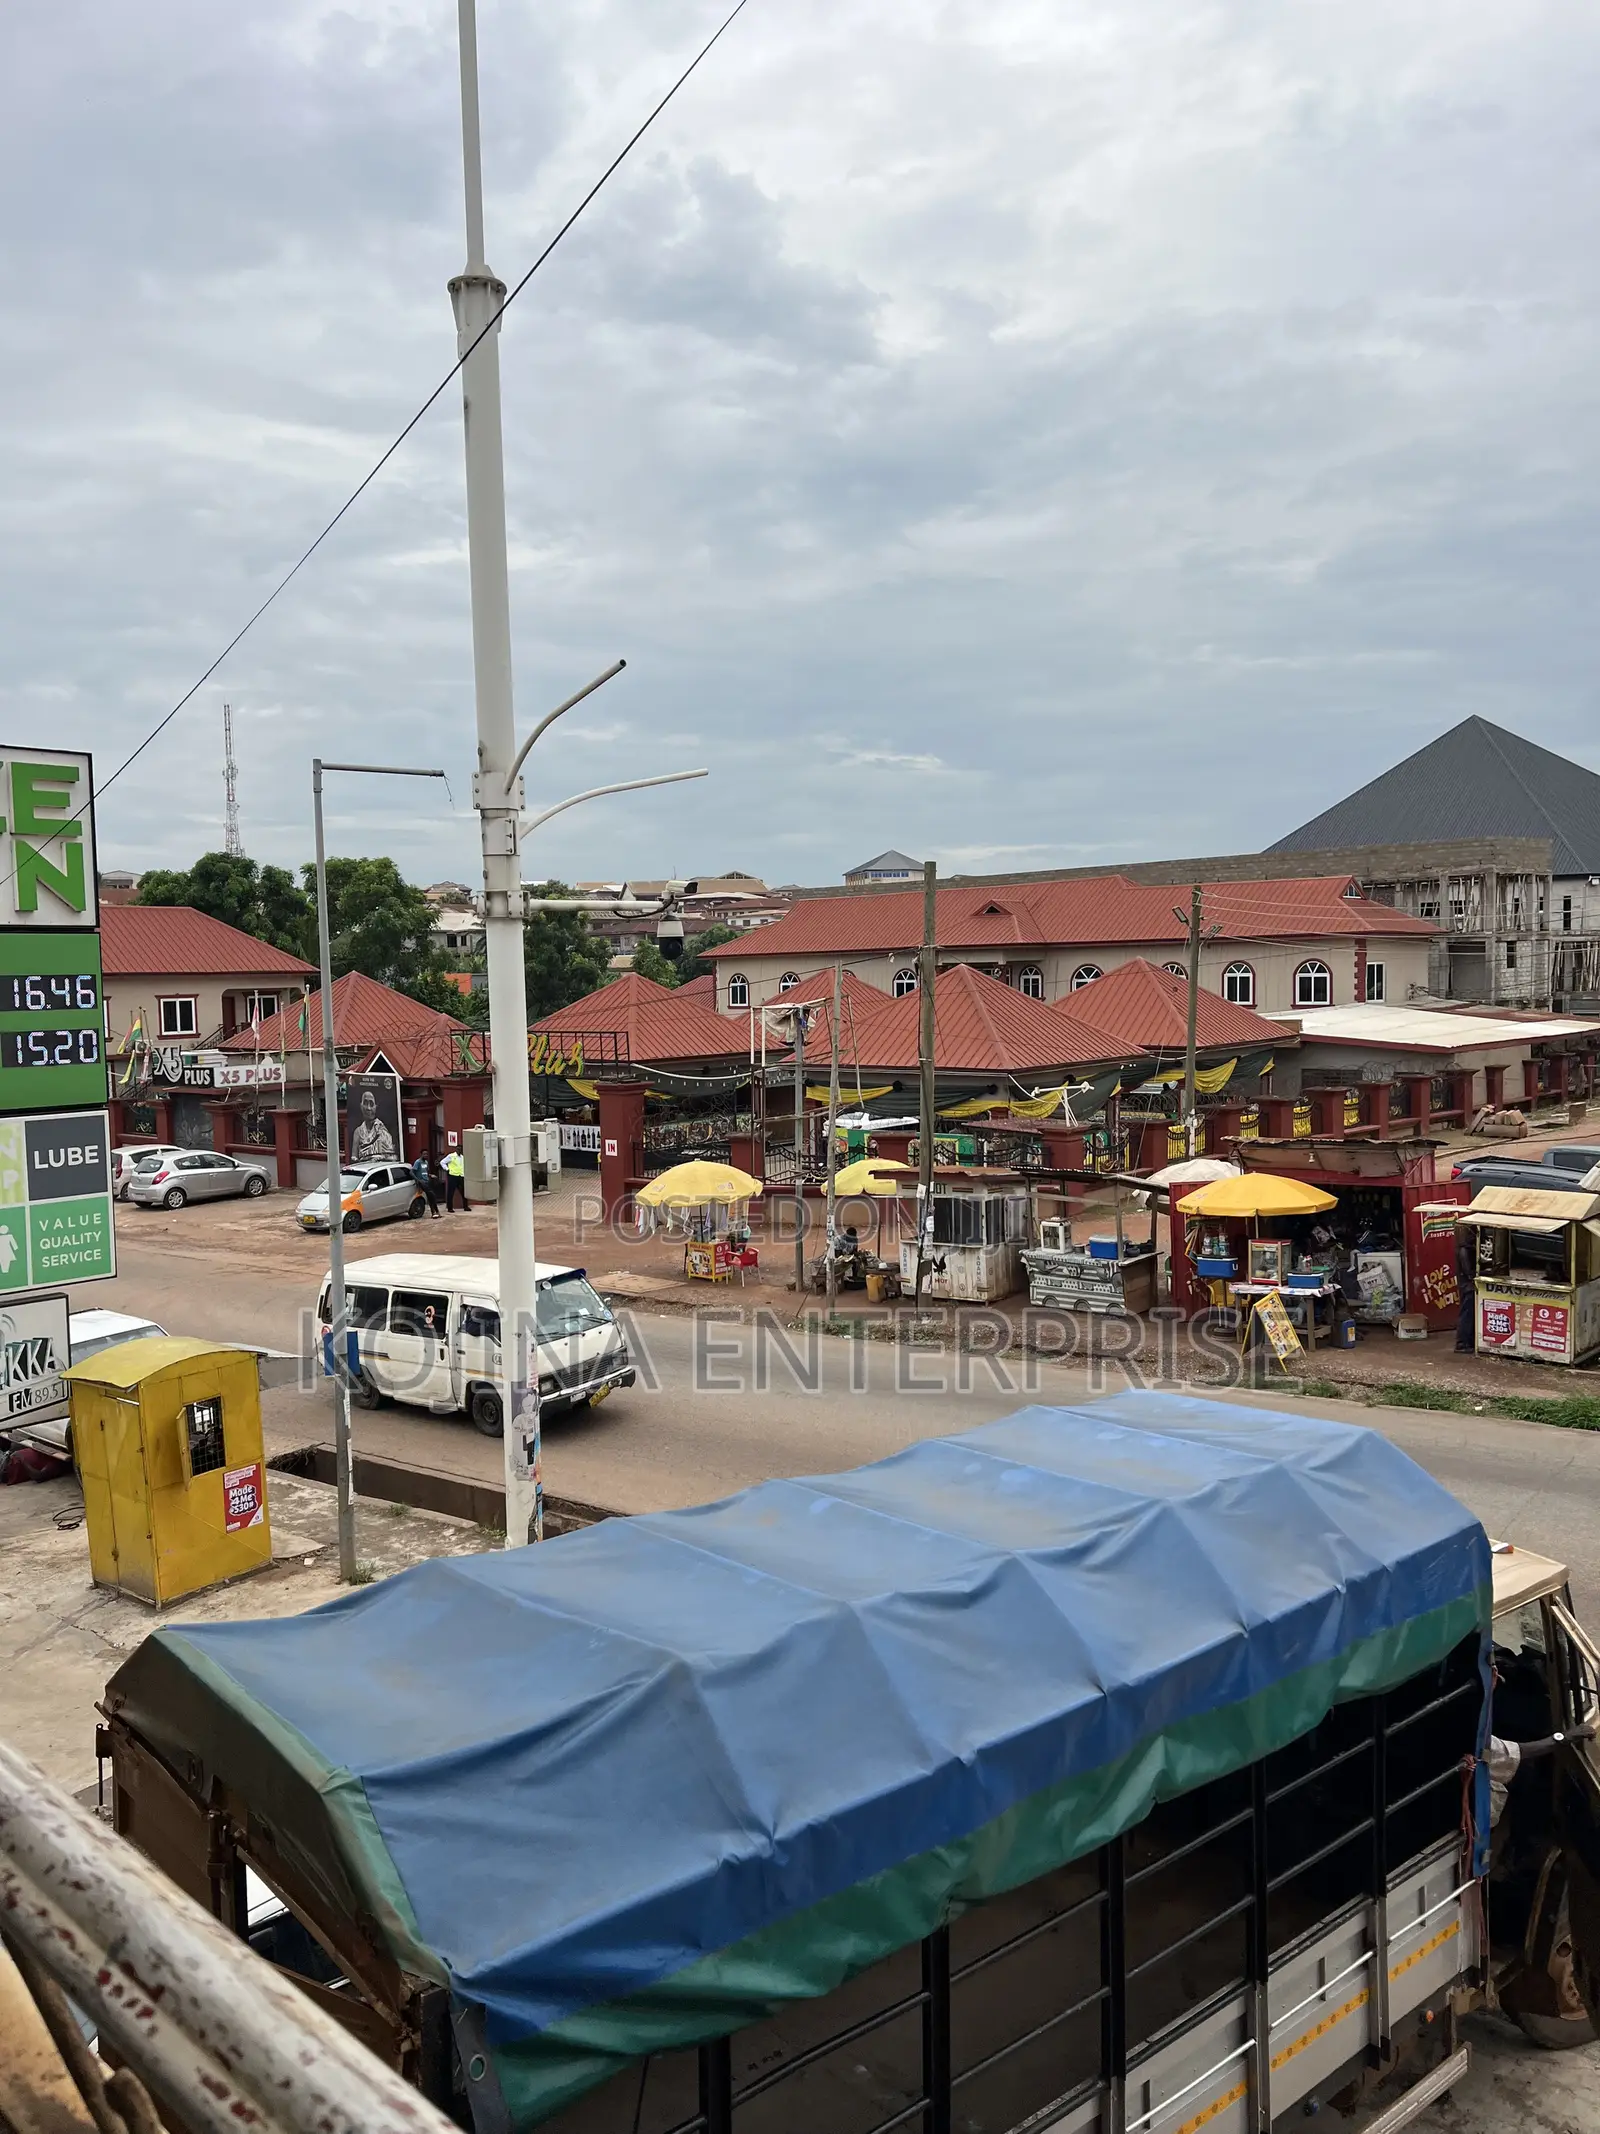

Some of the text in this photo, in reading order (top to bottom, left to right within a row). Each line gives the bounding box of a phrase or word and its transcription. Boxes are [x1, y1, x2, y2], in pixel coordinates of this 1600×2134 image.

[0, 760, 82, 838] E
[13, 975, 95, 1009] 16.46
[16, 1029, 98, 1065] 15.20
[184, 1069, 211, 1085] PLUS
[220, 1067, 282, 1085] X5 PLUS
[33, 1144, 99, 1170] LUBE
[608, 1143, 616, 1152] IN
[39, 1212, 102, 1232] VALUE
[39, 1231, 102, 1250] QUALITY
[41, 1249, 102, 1268] SERVICE
[1424, 1264, 1450, 1289] Love
[9, 1387, 33, 1413] FM
[229, 1485, 254, 1498] Made
[240, 1494, 253, 1503] Me
